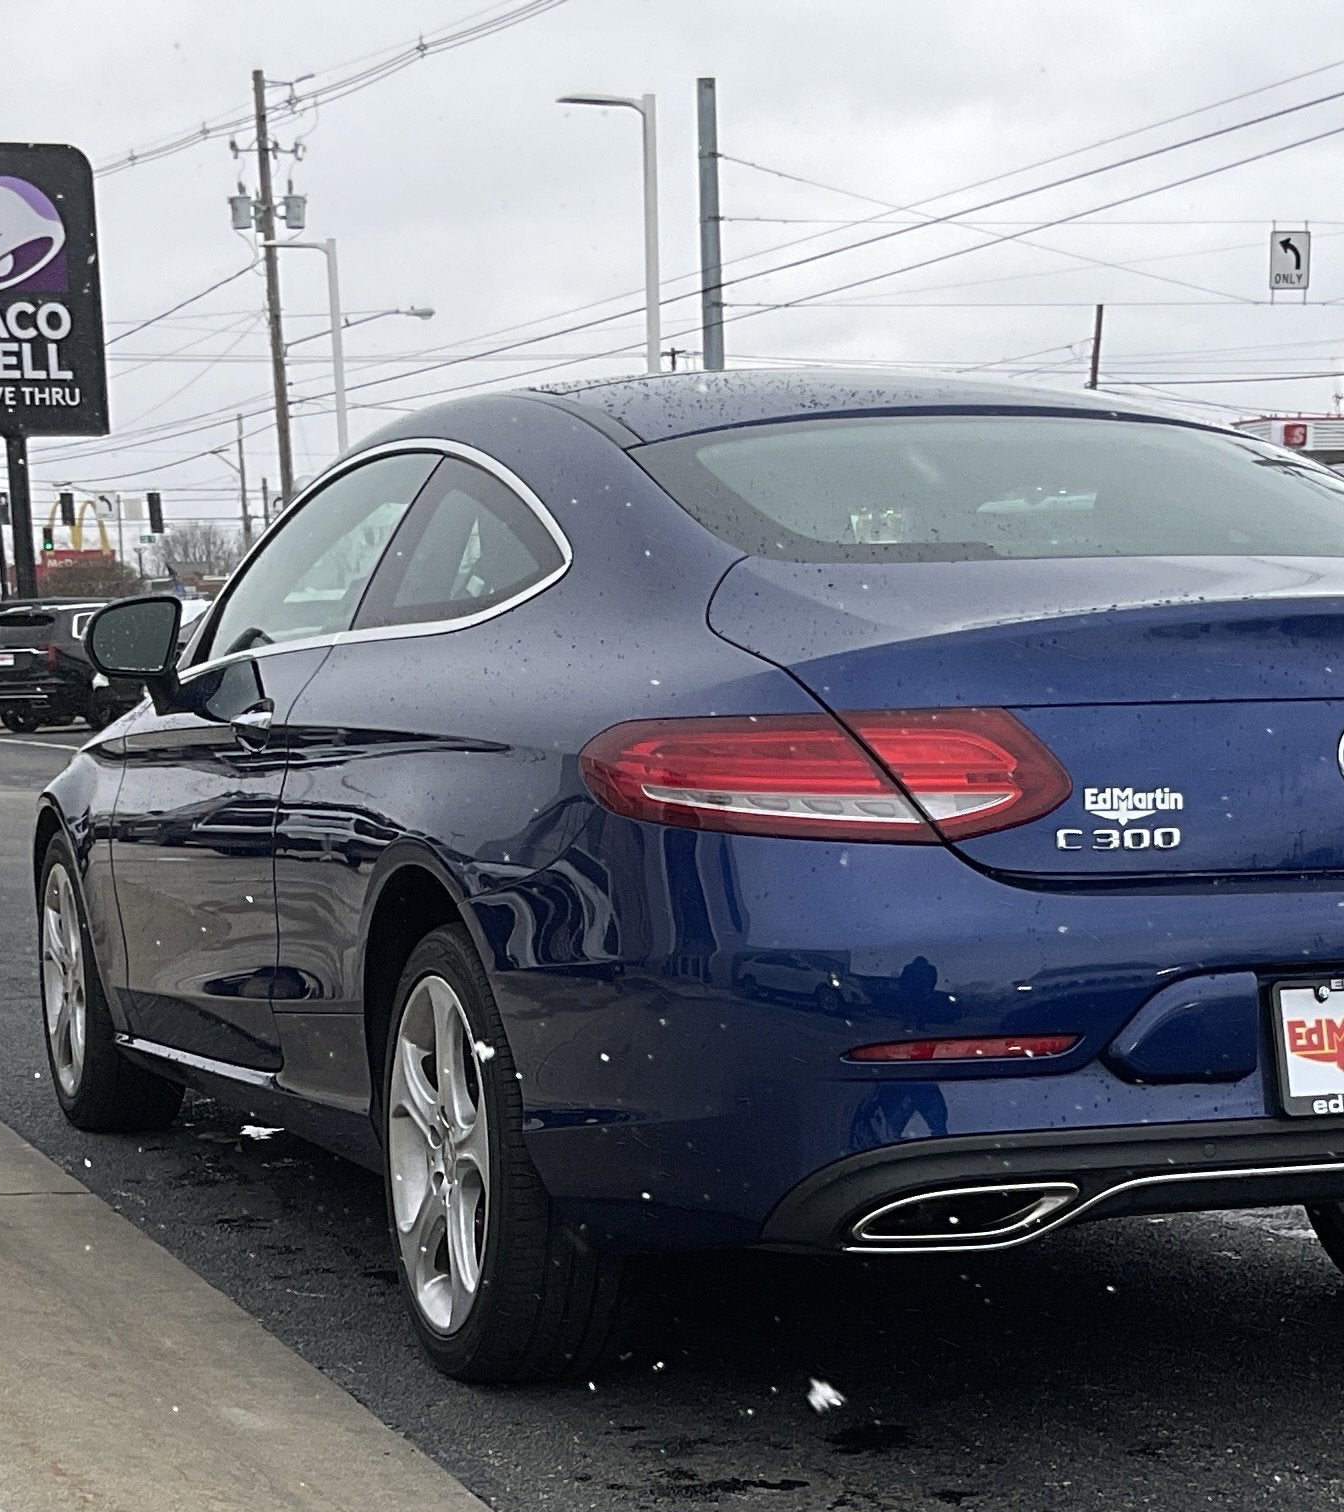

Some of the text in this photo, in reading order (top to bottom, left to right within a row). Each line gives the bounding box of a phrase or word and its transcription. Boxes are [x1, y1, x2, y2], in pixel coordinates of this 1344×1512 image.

[1274, 273, 1304, 285] ONLY
[21, 387, 81, 407] THRU
[1084, 787, 1184, 811] EdMartin
[1056, 827, 1181, 850] C 300
